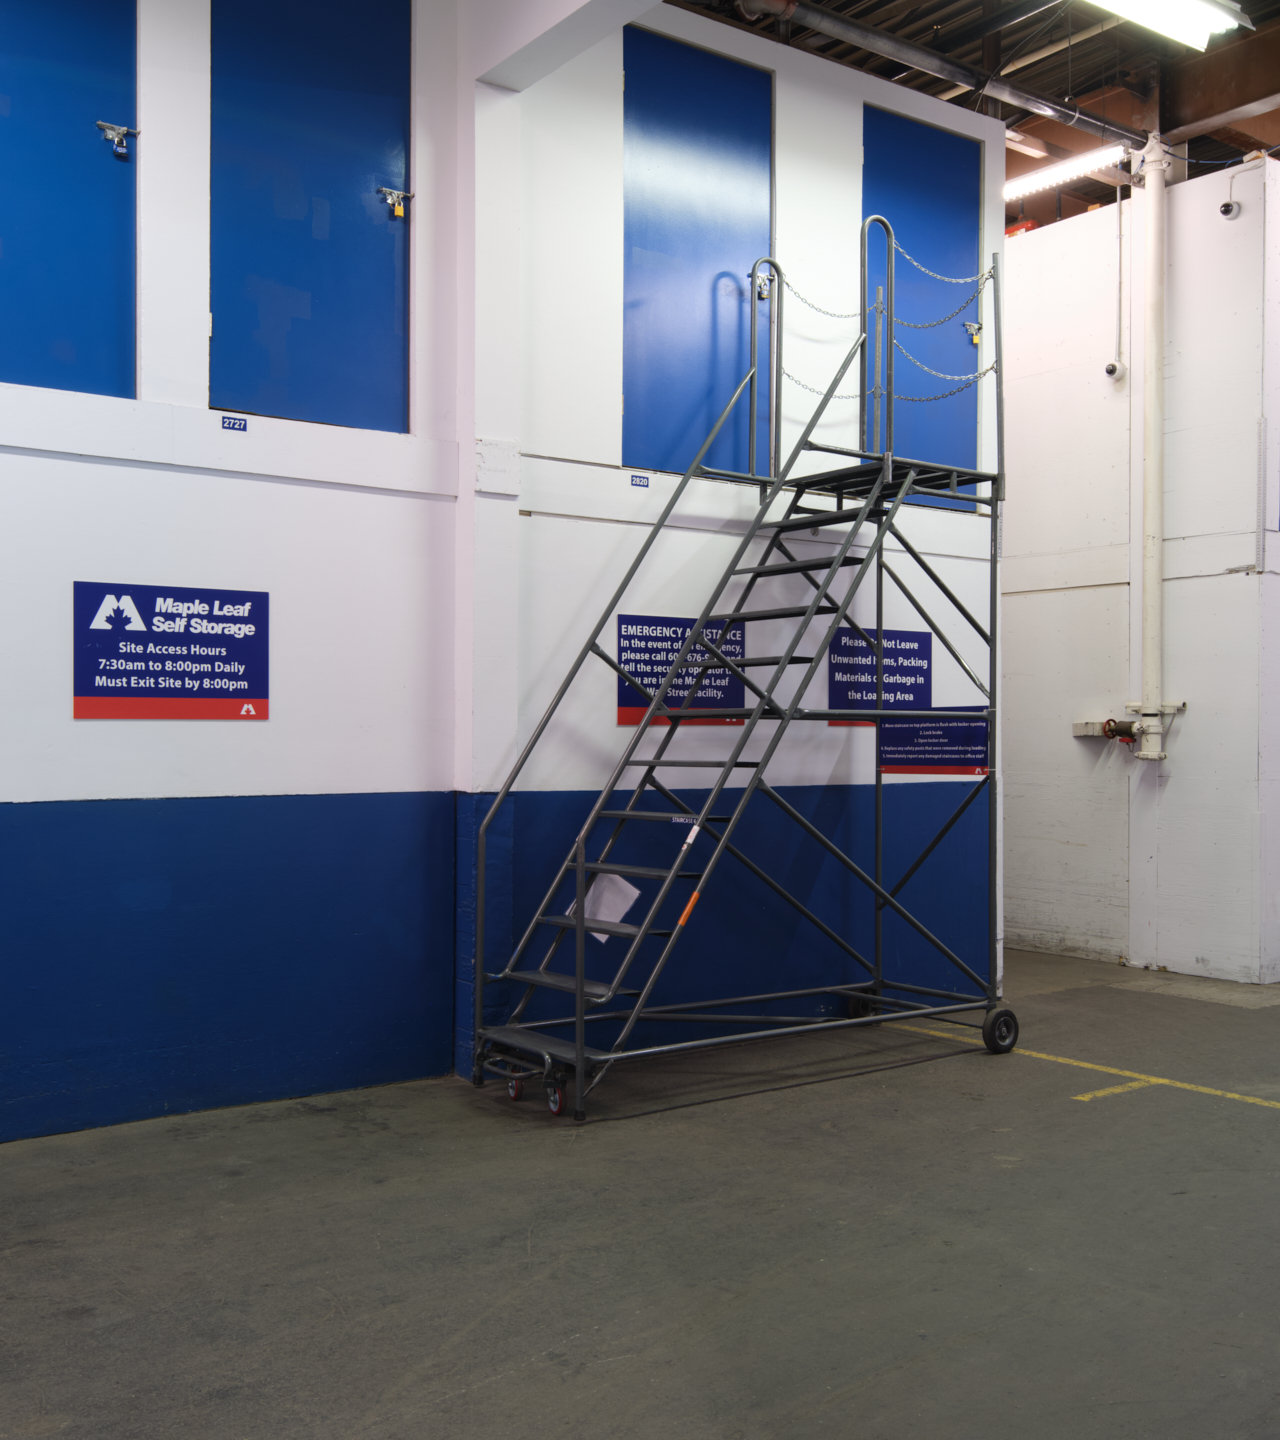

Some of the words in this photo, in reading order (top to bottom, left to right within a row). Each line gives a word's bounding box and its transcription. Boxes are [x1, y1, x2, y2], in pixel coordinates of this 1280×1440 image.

[223, 418, 246, 430] 2727
[632, 476, 648, 486] 2820
[154, 596, 210, 618] Maple
[212, 600, 253, 617] Leaf
[151, 615, 187, 633] Self
[189, 617, 257, 639] Storage
[621, 624, 683, 638] EMERGENCY
[118, 641, 144, 654] Site
[146, 642, 188, 655] Access
[190, 644, 227, 656] Hours
[620, 638, 629, 648] In
[631, 639, 646, 648] the
[647, 639, 672, 649] event
[673, 640, 682, 650] of
[841, 636, 867, 647] Please
[881, 638, 896, 649] Not
[896, 639, 919, 650] Leave
[621, 650, 650, 662] please
[651, 651, 667, 661] call
[830, 653, 872, 665] Unwanted
[898, 656, 928, 669] Packing
[98, 658, 146, 671] 7:30am
[148, 660, 162, 671] to
[164, 659, 212, 675] 8:00pm
[214, 661, 246, 676] Daily
[620, 662, 635, 672] tell
[637, 662, 652, 672] the
[94, 675, 128, 688] Must
[130, 676, 156, 688] Exit
[157, 676, 183, 689] Site
[184, 677, 200, 691] by
[202, 678, 249, 692] 8:00pm
[643, 676, 657, 685] are
[711, 676, 729, 687] Leaf
[834, 671, 872, 683] Materials
[882, 673, 916, 686] Garbage
[916, 674, 925, 684] in
[847, 690, 862, 700] the
[863, 690, 895, 703] Loaing
[895, 691, 914, 701] Area
